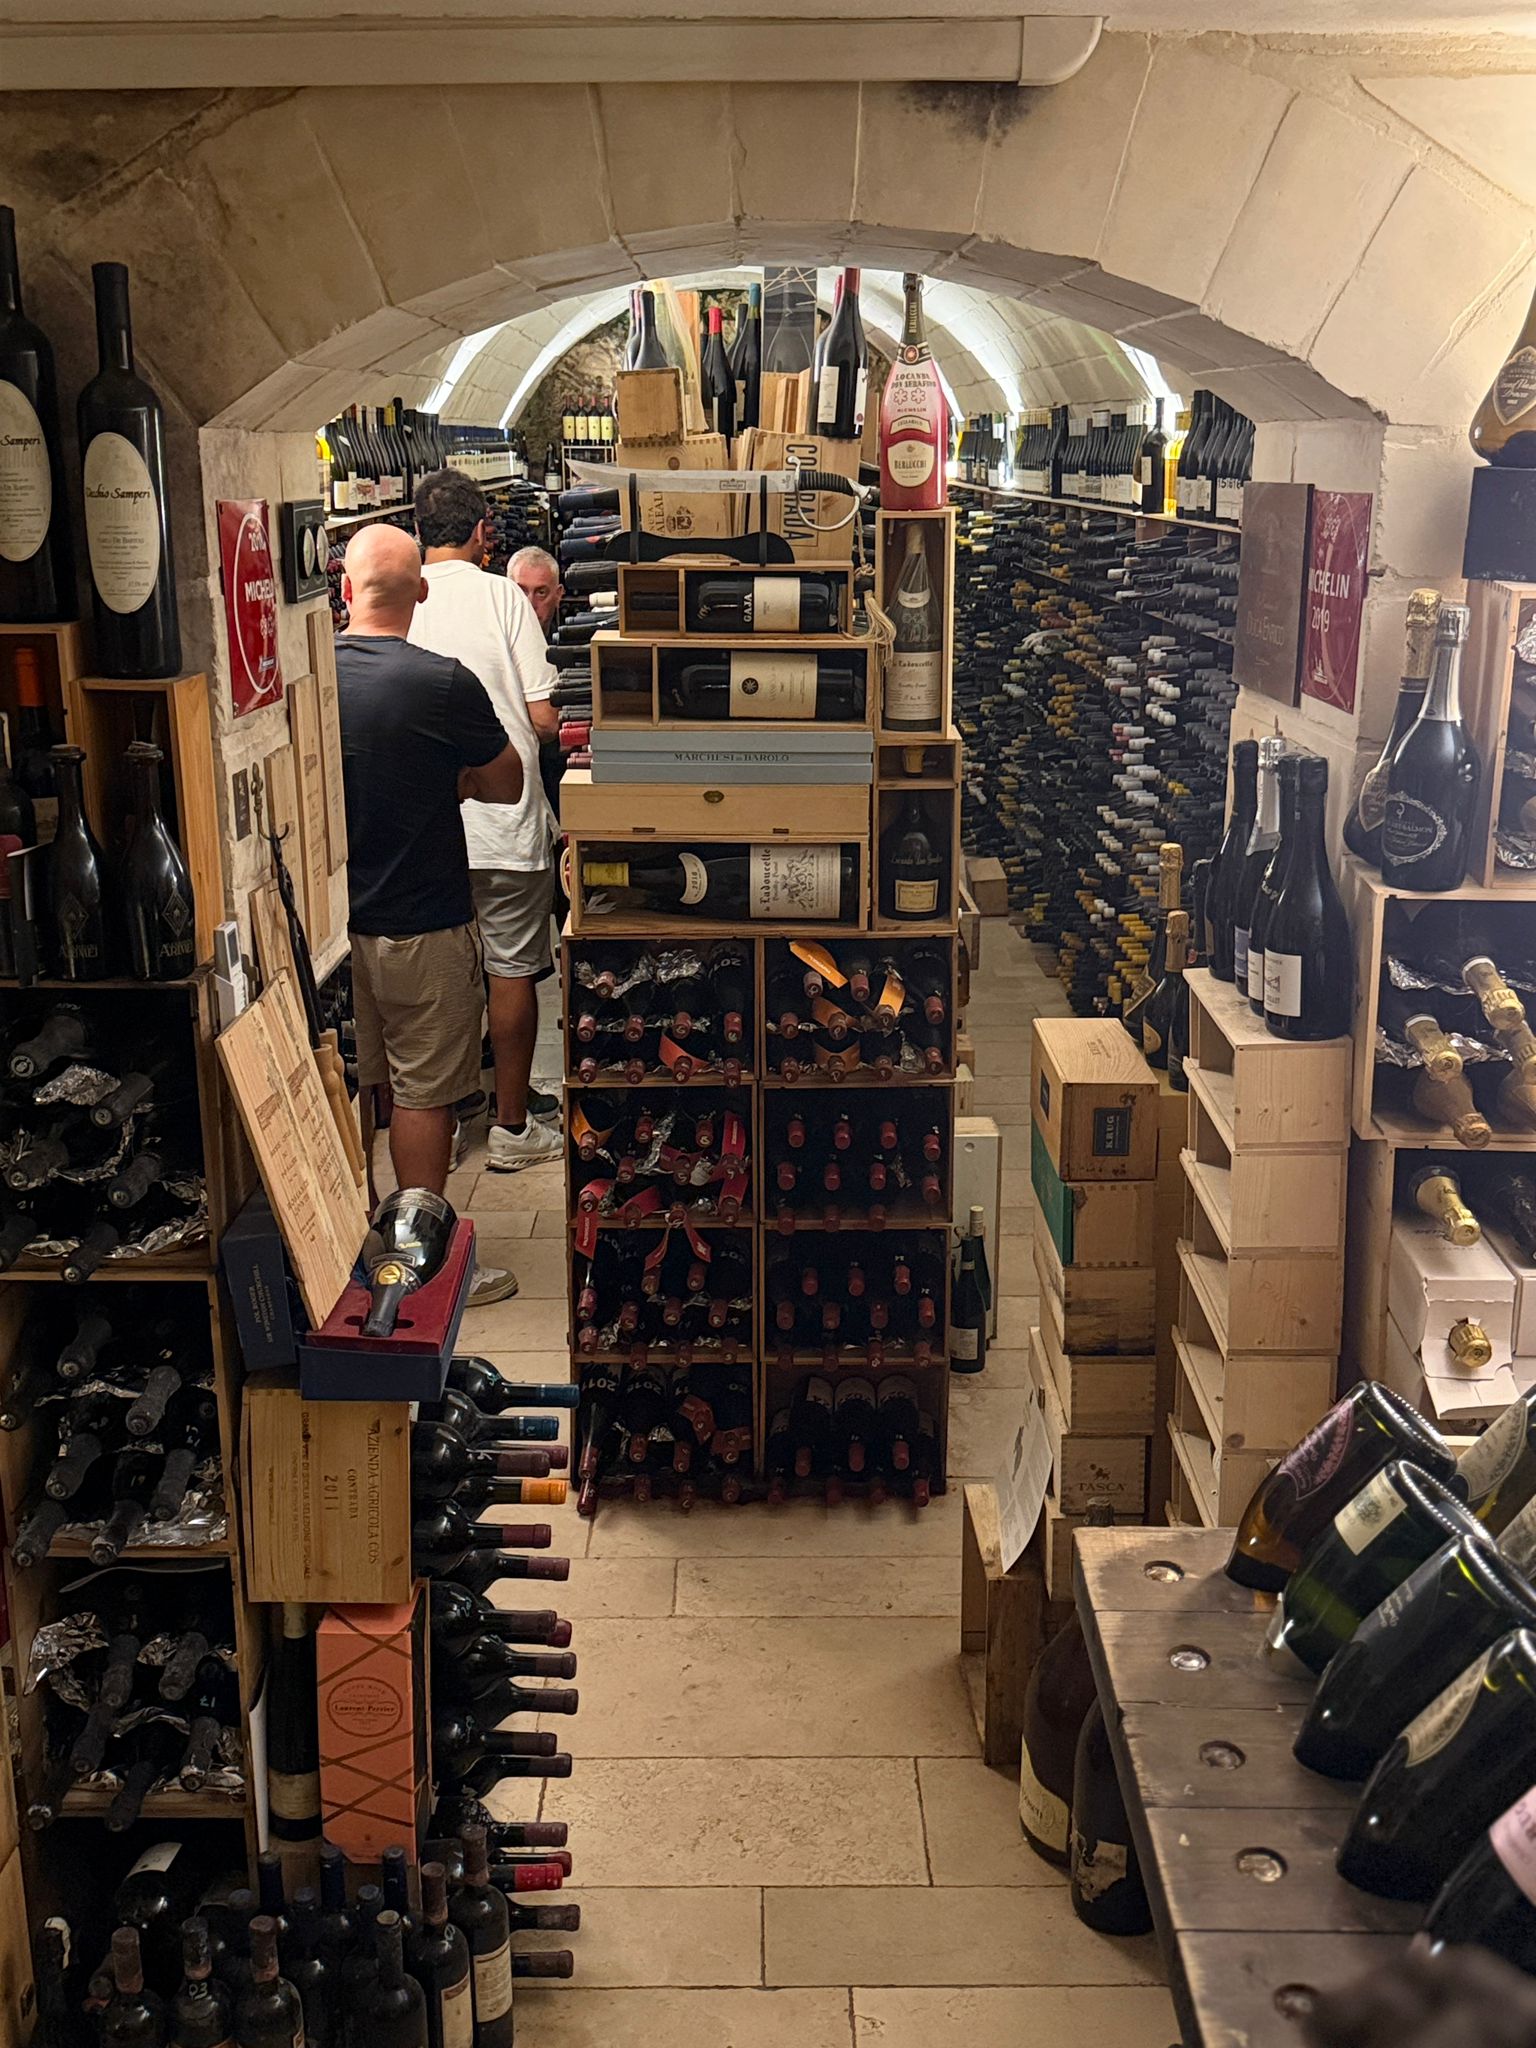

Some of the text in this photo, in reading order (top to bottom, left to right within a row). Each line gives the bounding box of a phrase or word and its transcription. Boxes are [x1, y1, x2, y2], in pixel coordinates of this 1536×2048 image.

[111, 487, 151, 505] Samperi
[783, 444, 818, 541] CORADA
[743, 592, 752, 622] GAJA
[1311, 606, 1330, 632] 2019
[673, 753, 734, 761] MARCHESI
[744, 753, 790, 761] BAROLO
[1105, 1115, 1115, 1149] KRUG
[323, 1474, 339, 1511] 2011
[367, 1427, 381, 1564] AZIENDA AGRICOLA COS
[1077, 1482, 1126, 1491] TASCA
